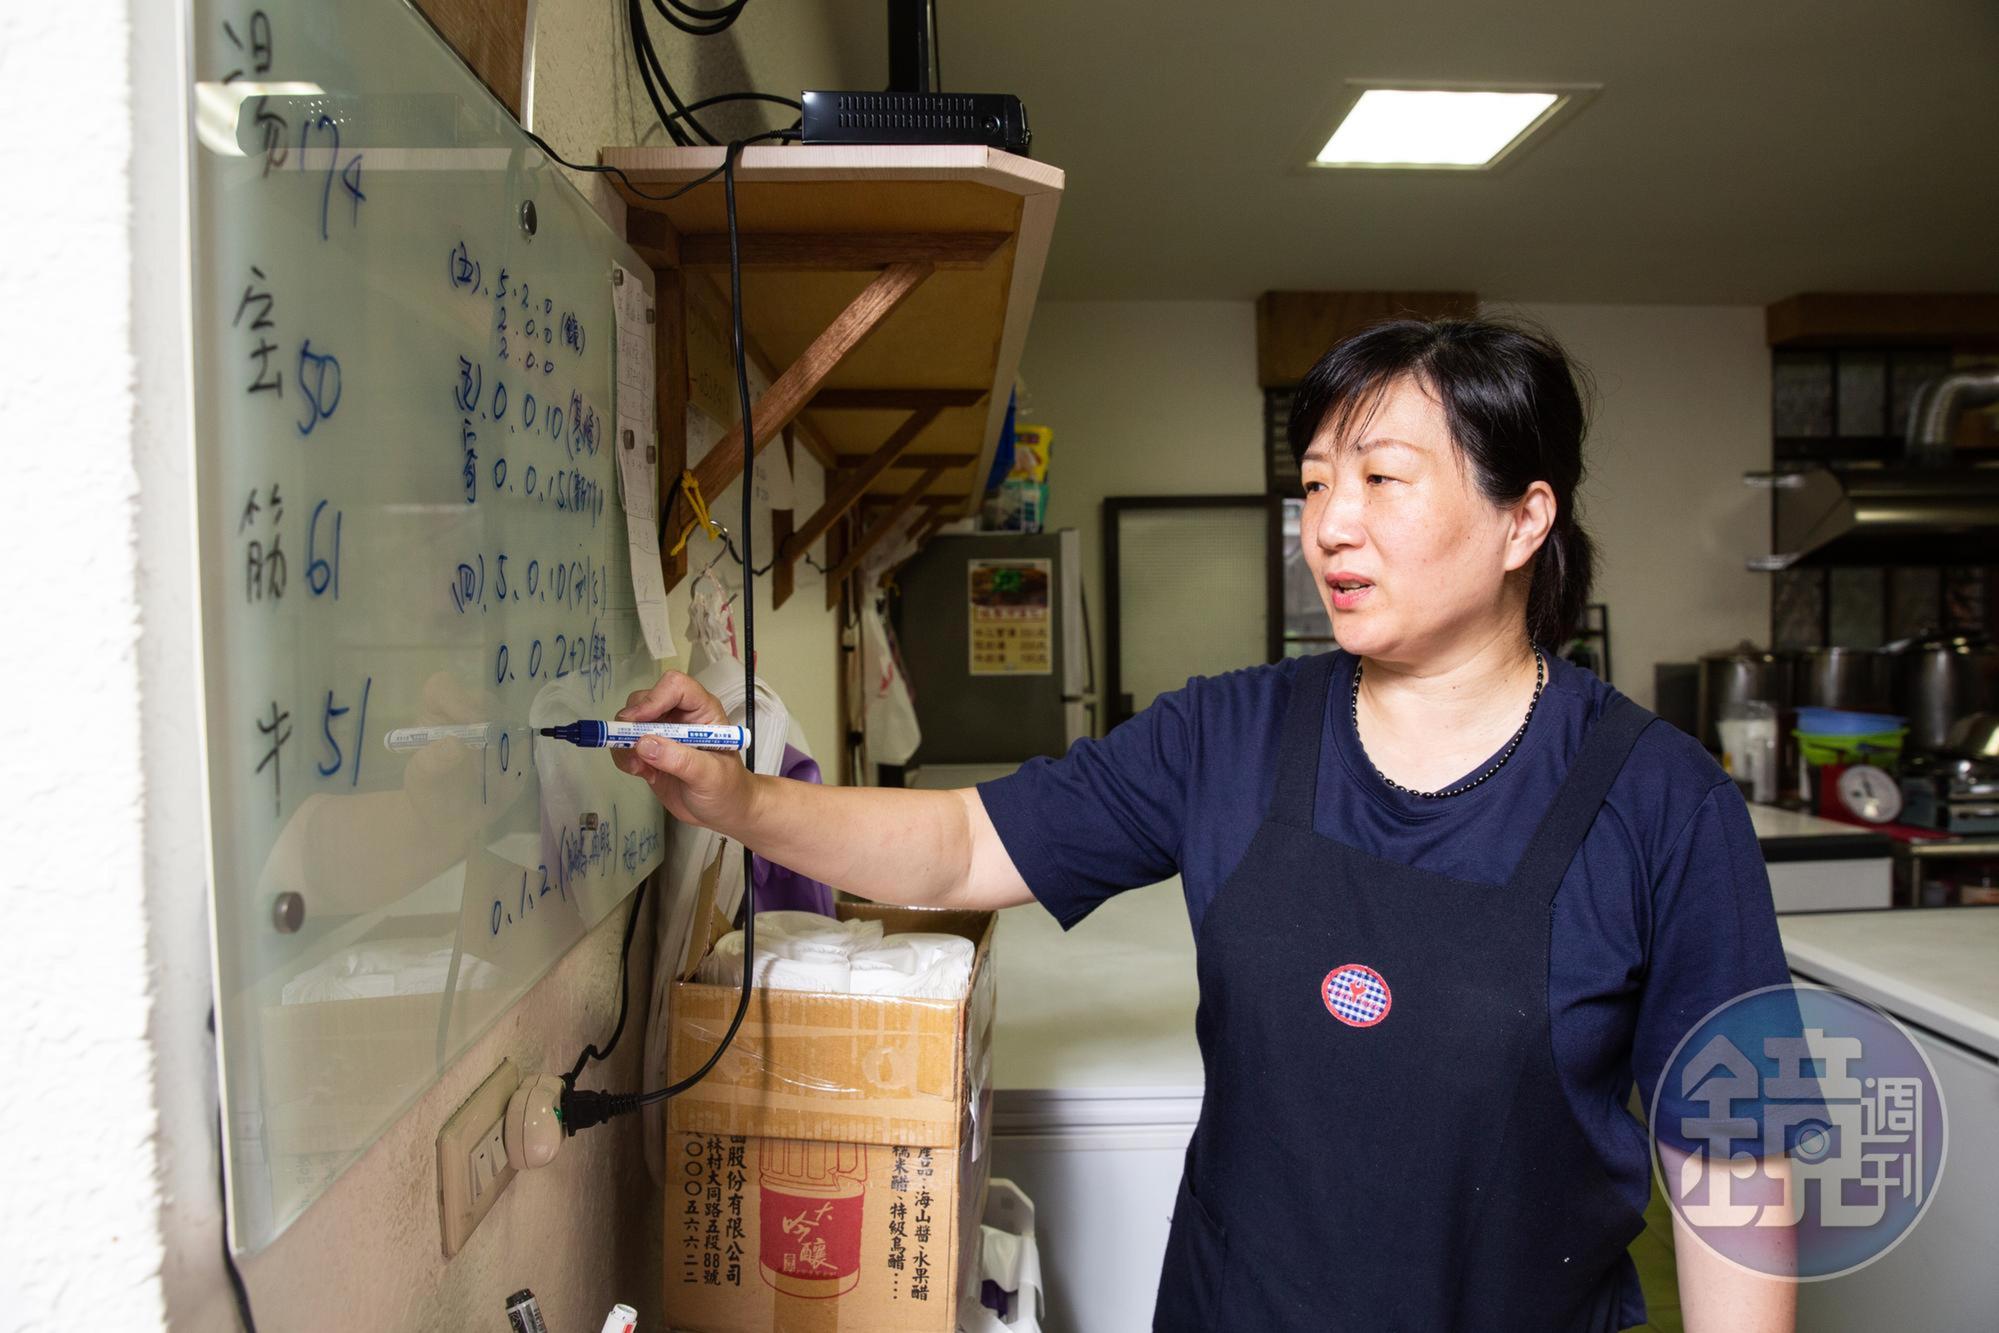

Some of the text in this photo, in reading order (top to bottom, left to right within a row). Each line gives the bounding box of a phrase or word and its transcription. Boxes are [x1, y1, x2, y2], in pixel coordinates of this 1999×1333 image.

[298, 339, 342, 436] 50
[305, 499, 342, 601] 61
[254, 676, 371, 818] 牛 51
